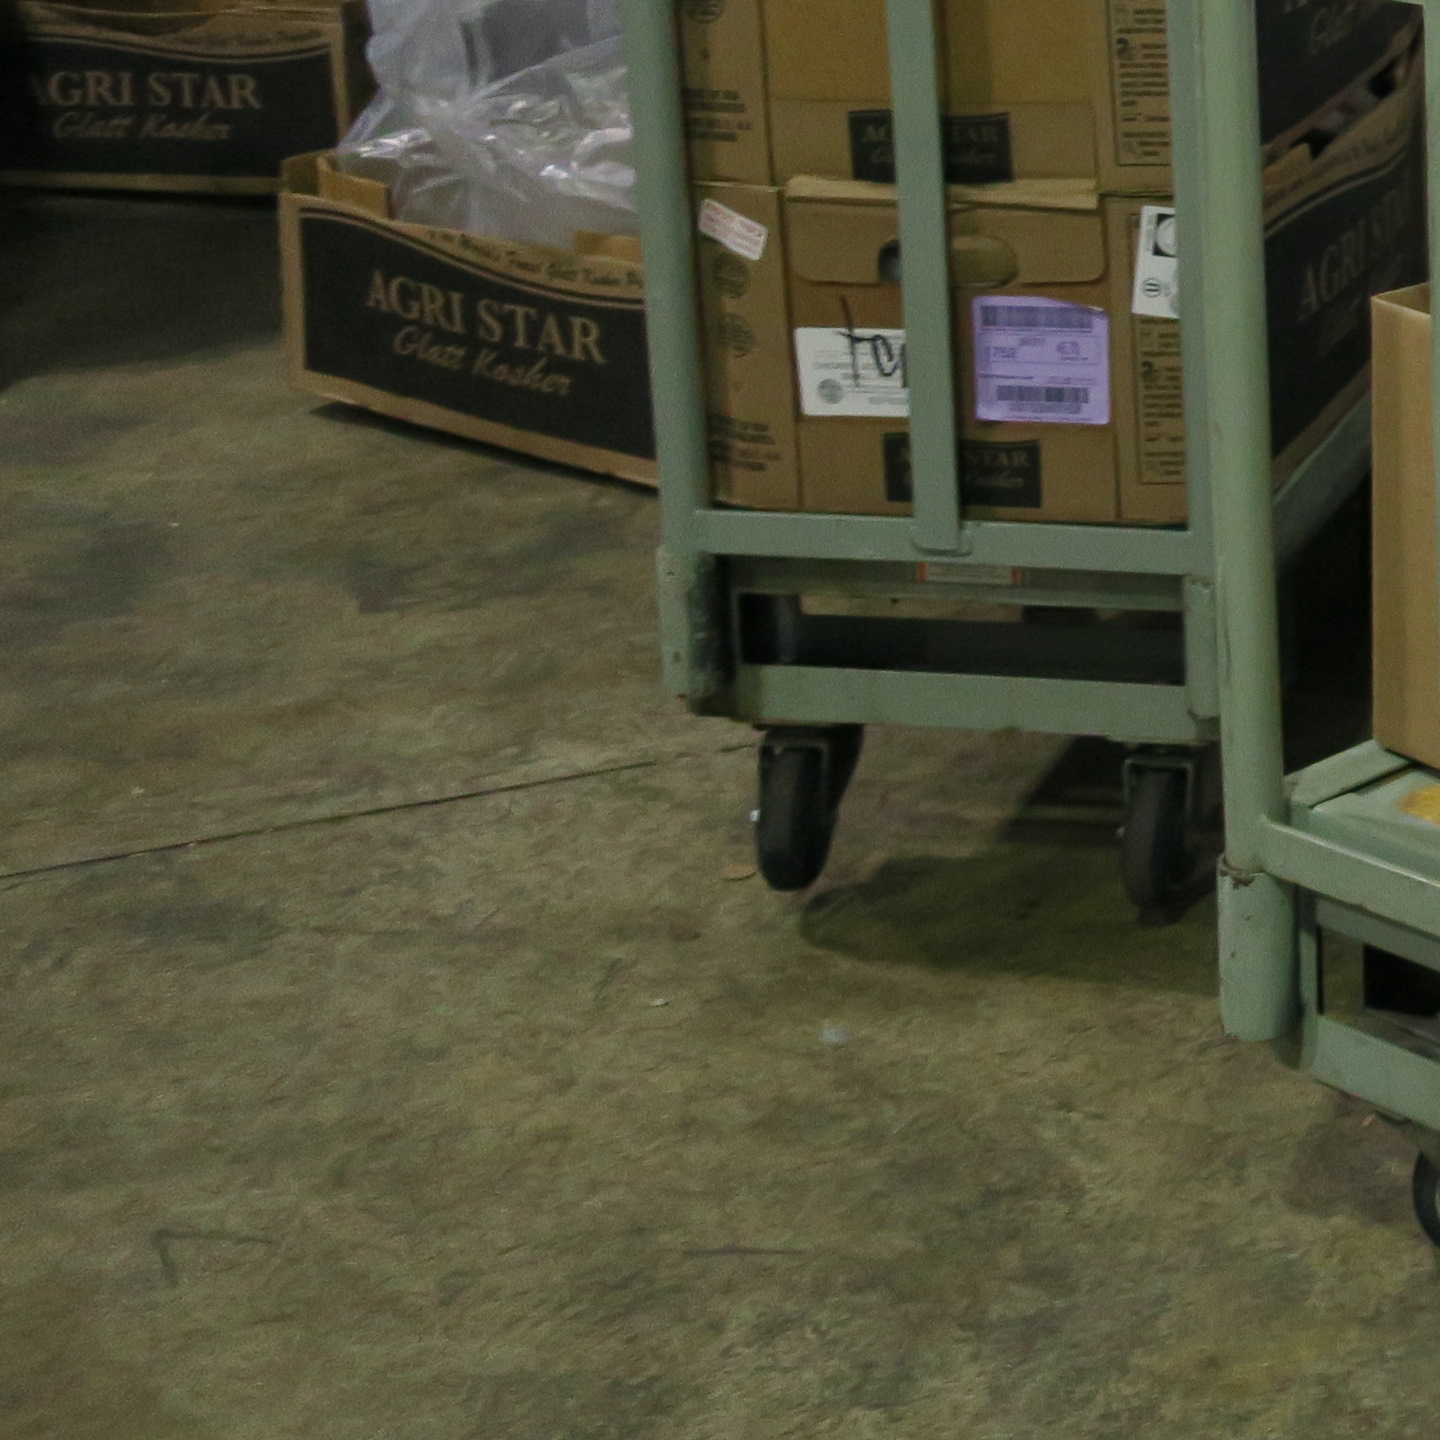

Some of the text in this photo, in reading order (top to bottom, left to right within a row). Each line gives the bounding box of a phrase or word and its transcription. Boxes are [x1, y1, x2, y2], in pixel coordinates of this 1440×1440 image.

[148, 71, 264, 109] STAR
[366, 268, 606, 364] AGRI STAR
[394, 324, 573, 396] Glatt Kosher
